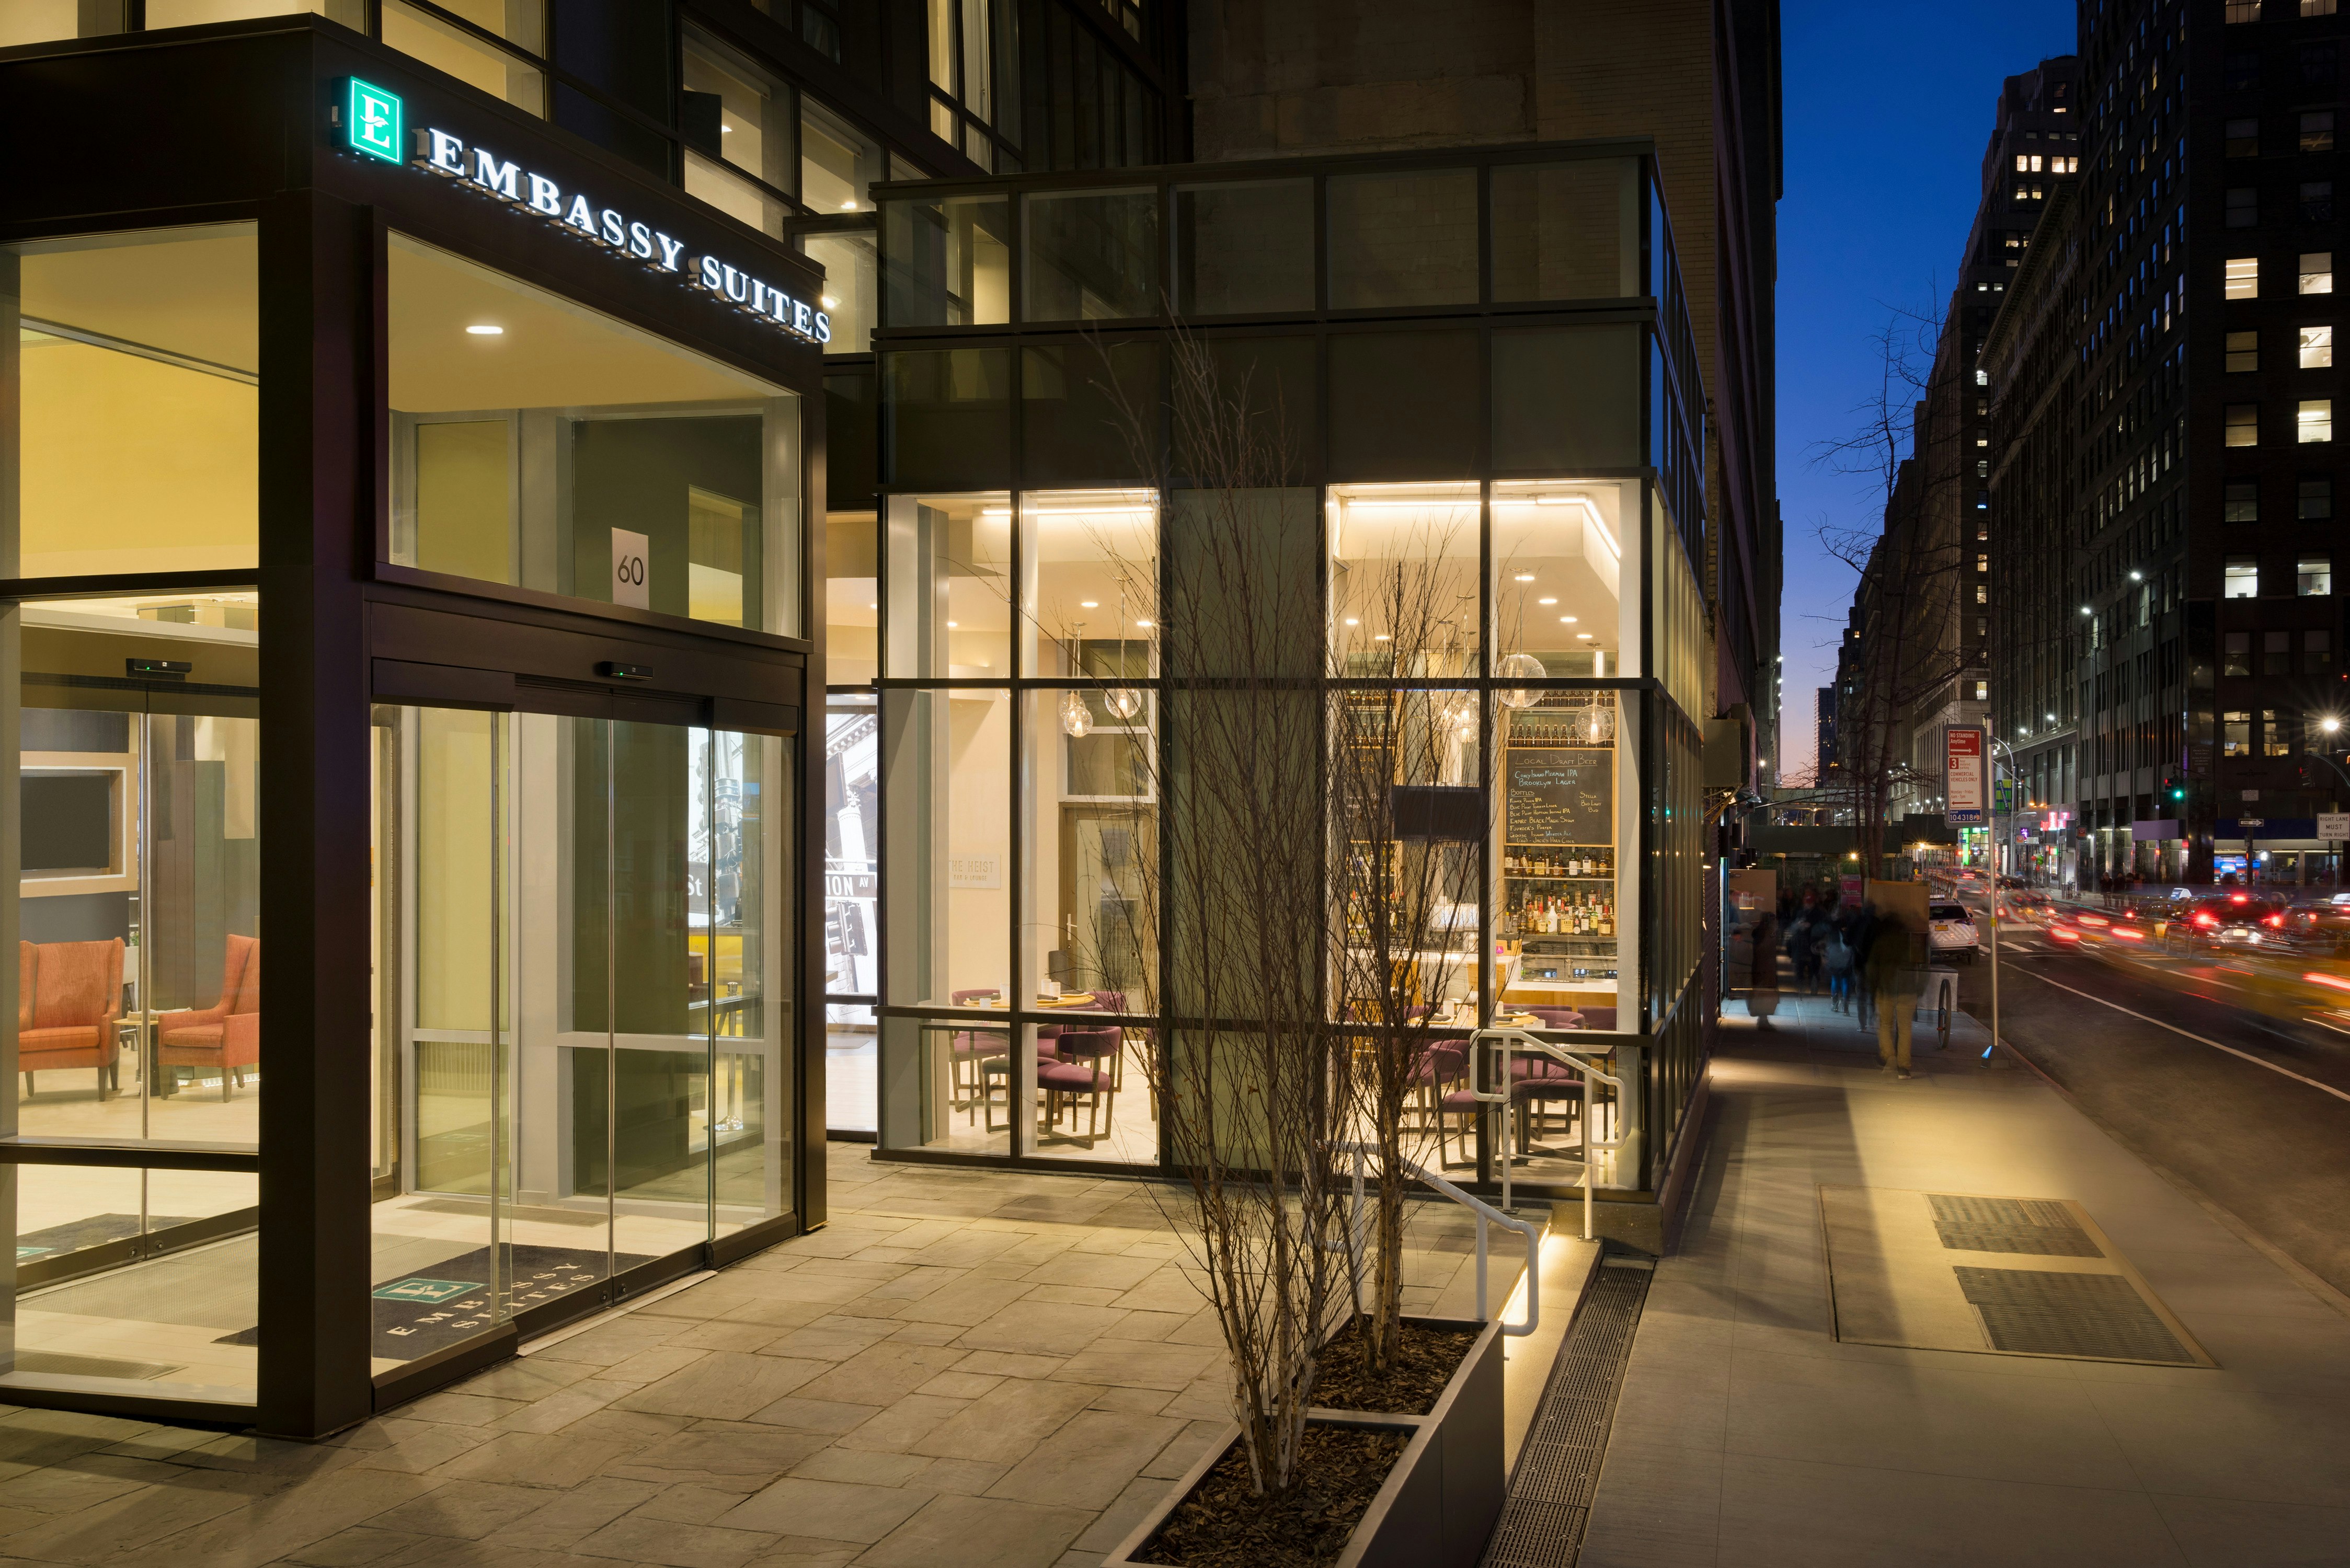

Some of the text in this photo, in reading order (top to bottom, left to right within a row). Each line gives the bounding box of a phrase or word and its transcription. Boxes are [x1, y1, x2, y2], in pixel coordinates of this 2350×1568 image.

[429, 127, 831, 343] EMBASSY SUITES
[618, 555, 644, 586] 60
[1515, 753, 1597, 765] LOCAL DRAFT BEER
[1951, 758, 1956, 768] 3
[949, 860, 994, 873] HE HEIST
[859, 877, 868, 887] AV
[386, 1263, 582, 1336] EMBASSY
[451, 1274, 594, 1329] SUITES
